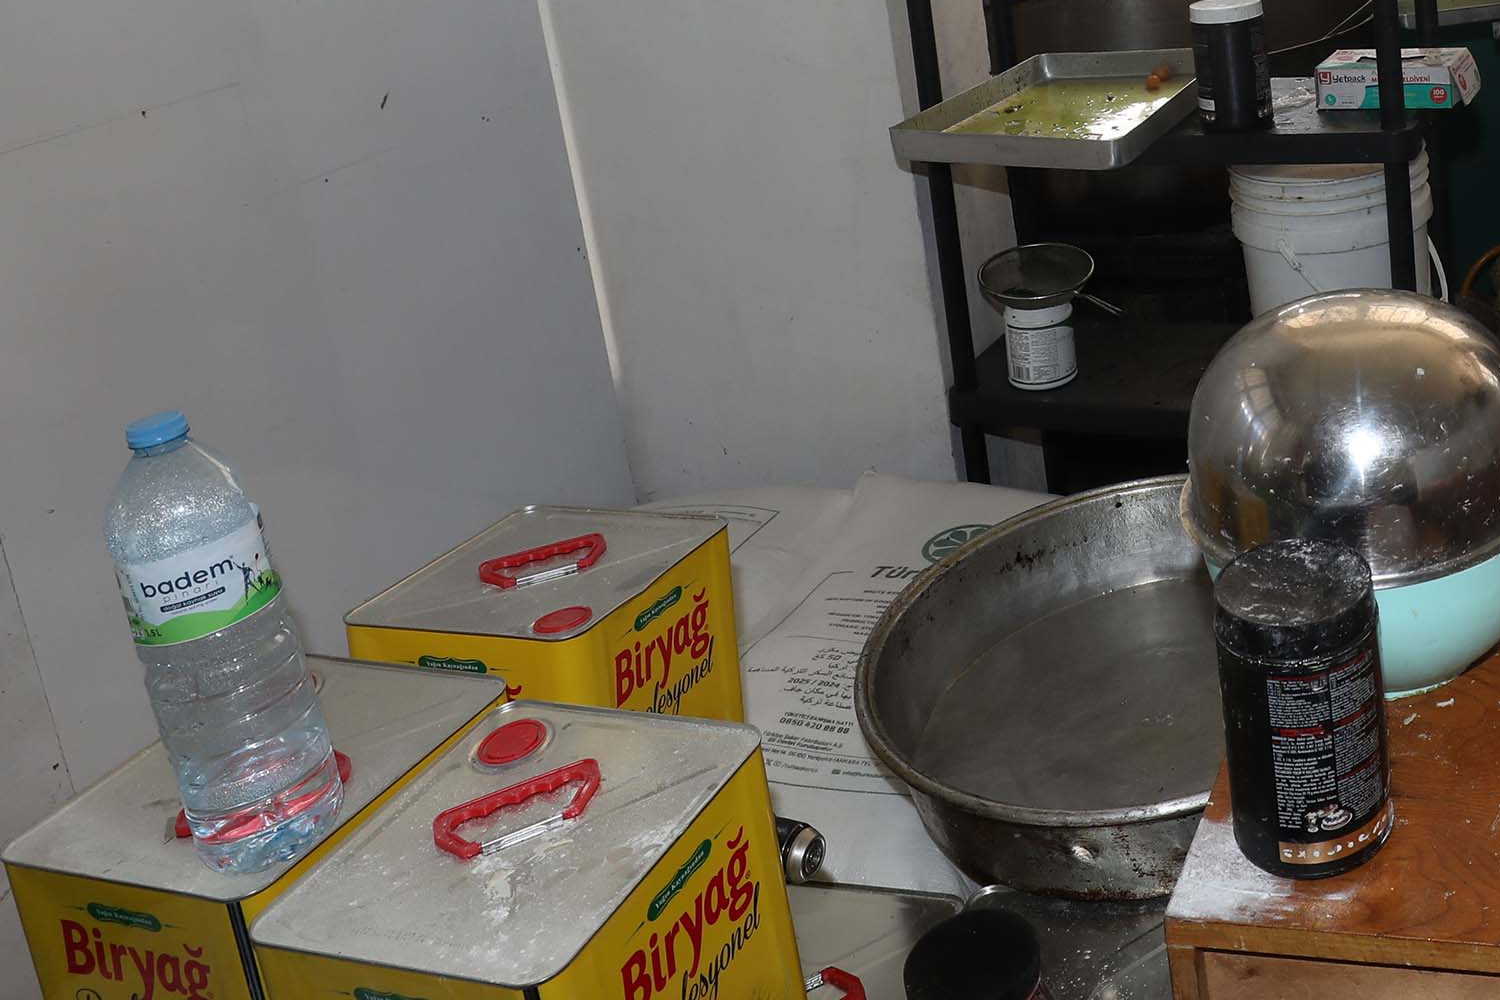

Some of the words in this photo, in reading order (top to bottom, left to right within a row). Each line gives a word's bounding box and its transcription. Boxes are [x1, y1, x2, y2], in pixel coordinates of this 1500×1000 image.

[140, 558, 234, 598] badem
[614, 586, 710, 709] Biryağ
[60, 919, 211, 1000] Biryağ
[620, 825, 754, 1000] Biryağ
